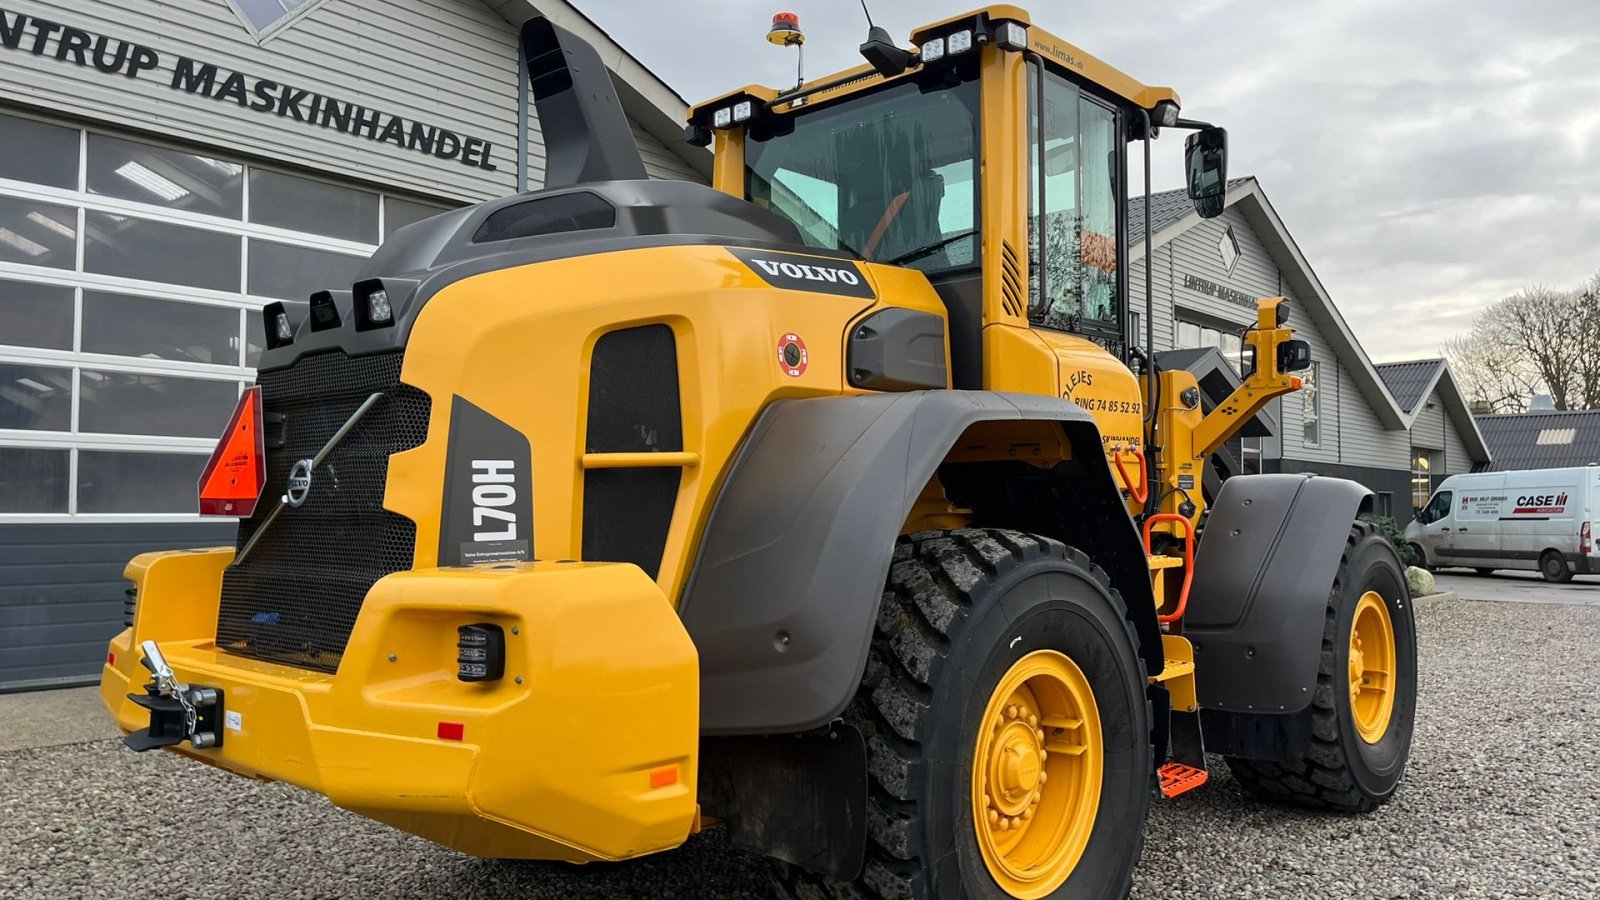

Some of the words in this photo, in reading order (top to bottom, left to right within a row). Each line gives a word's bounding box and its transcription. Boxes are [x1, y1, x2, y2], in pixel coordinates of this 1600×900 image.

[171, 55, 497, 171] MASKINHANDEL
[751, 258, 859, 286] VOLVO
[1074, 397, 1095, 411] RING
[1096, 399, 1107, 411] 74
[1108, 400, 1119, 412] 85
[1120, 401, 1130, 413] 52
[1131, 402, 1141, 415] 92
[471, 460, 517, 542] L70H
[1516, 495, 1555, 507] CASE
